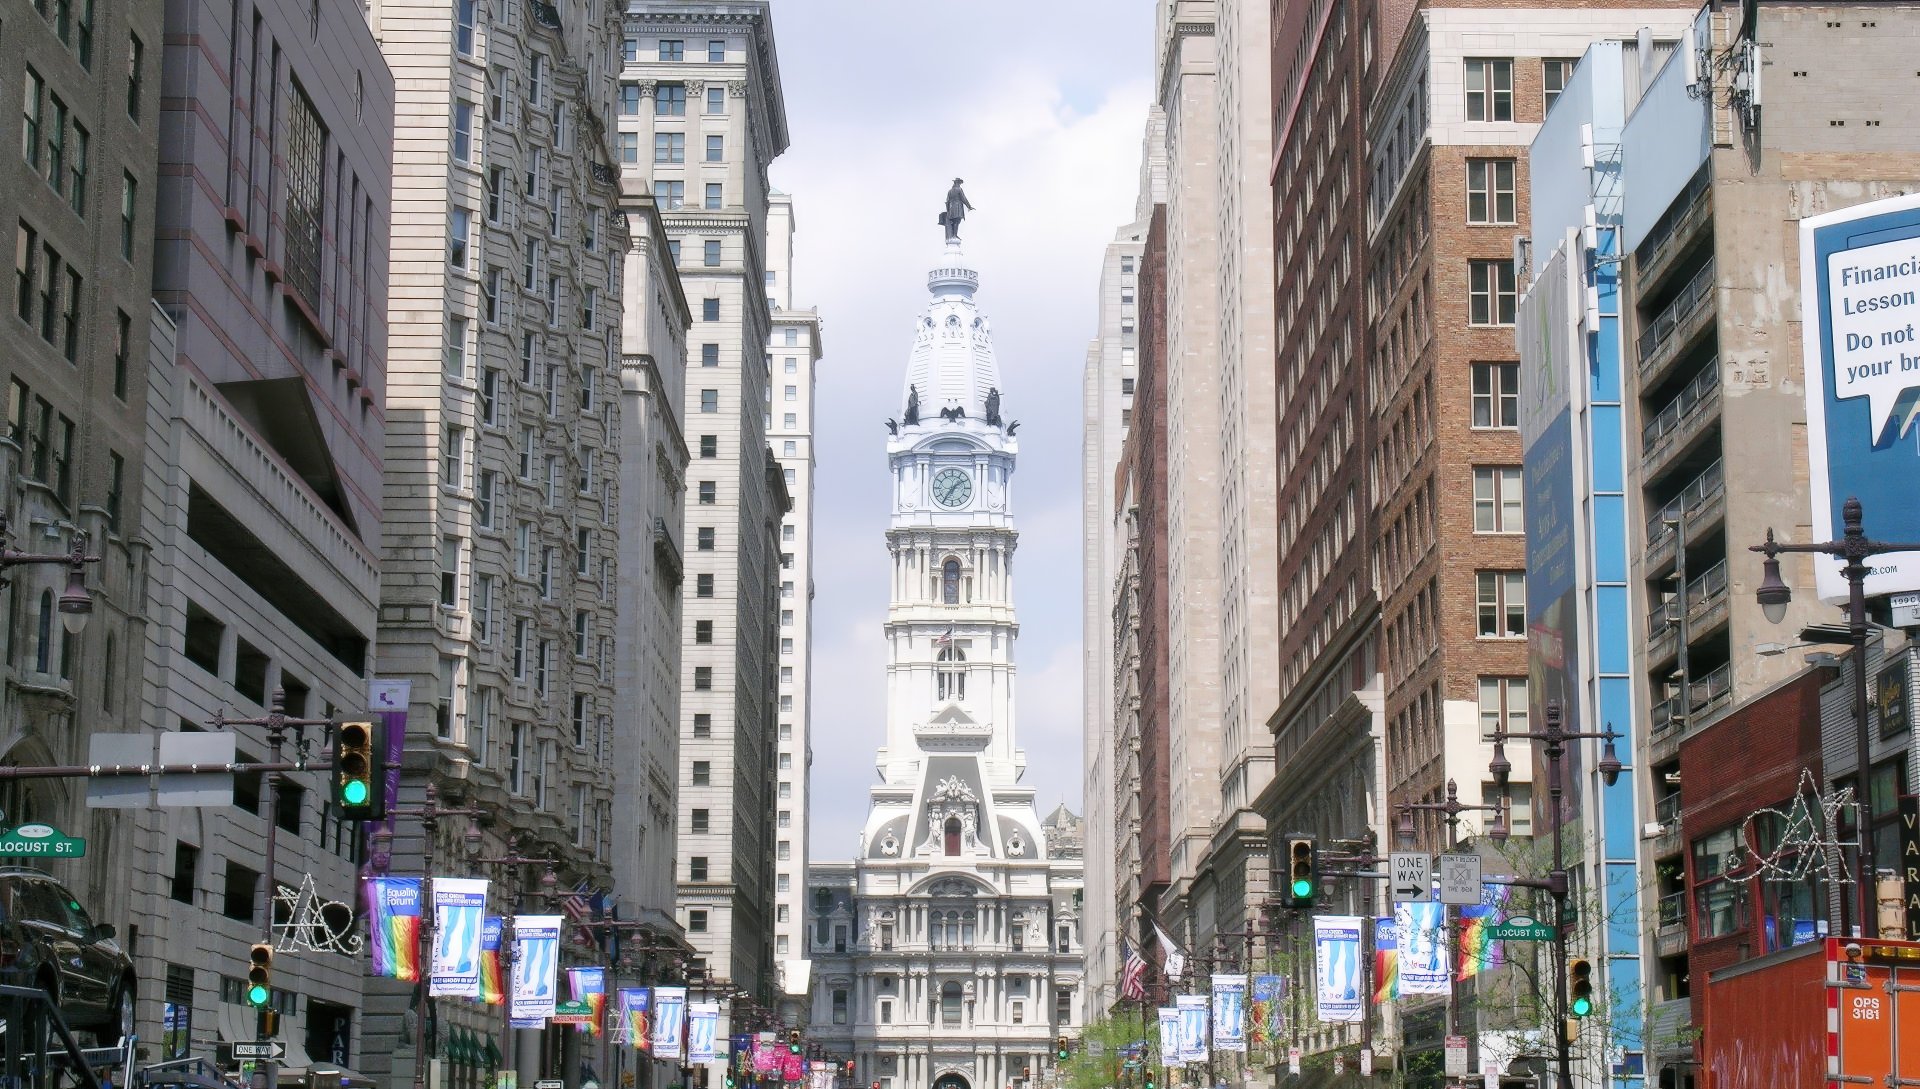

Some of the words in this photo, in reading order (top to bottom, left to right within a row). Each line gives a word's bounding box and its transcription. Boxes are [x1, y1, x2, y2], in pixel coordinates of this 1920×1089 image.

[1841, 255, 1920, 288] Financi
[1843, 290, 1915, 316] Lesson
[1847, 332, 1873, 352] Do
[1881, 323, 1914, 346] not
[1847, 360, 1893, 384] your
[0, 842, 49, 852] LOCUST
[55, 842, 72, 852] ST.
[1397, 857, 1423, 868] ONE
[1397, 870, 1424, 881] WAY
[387, 887, 418, 899] Equality
[387, 898, 414, 906] Forum
[1496, 928, 1530, 937] LOCUST
[1534, 928, 1547, 937] ST.
[1853, 997, 1880, 1009] OPS
[1852, 1008, 1880, 1020] 3181
[238, 1045, 253, 1054] ONE
[255, 1045, 271, 1055] WAY
